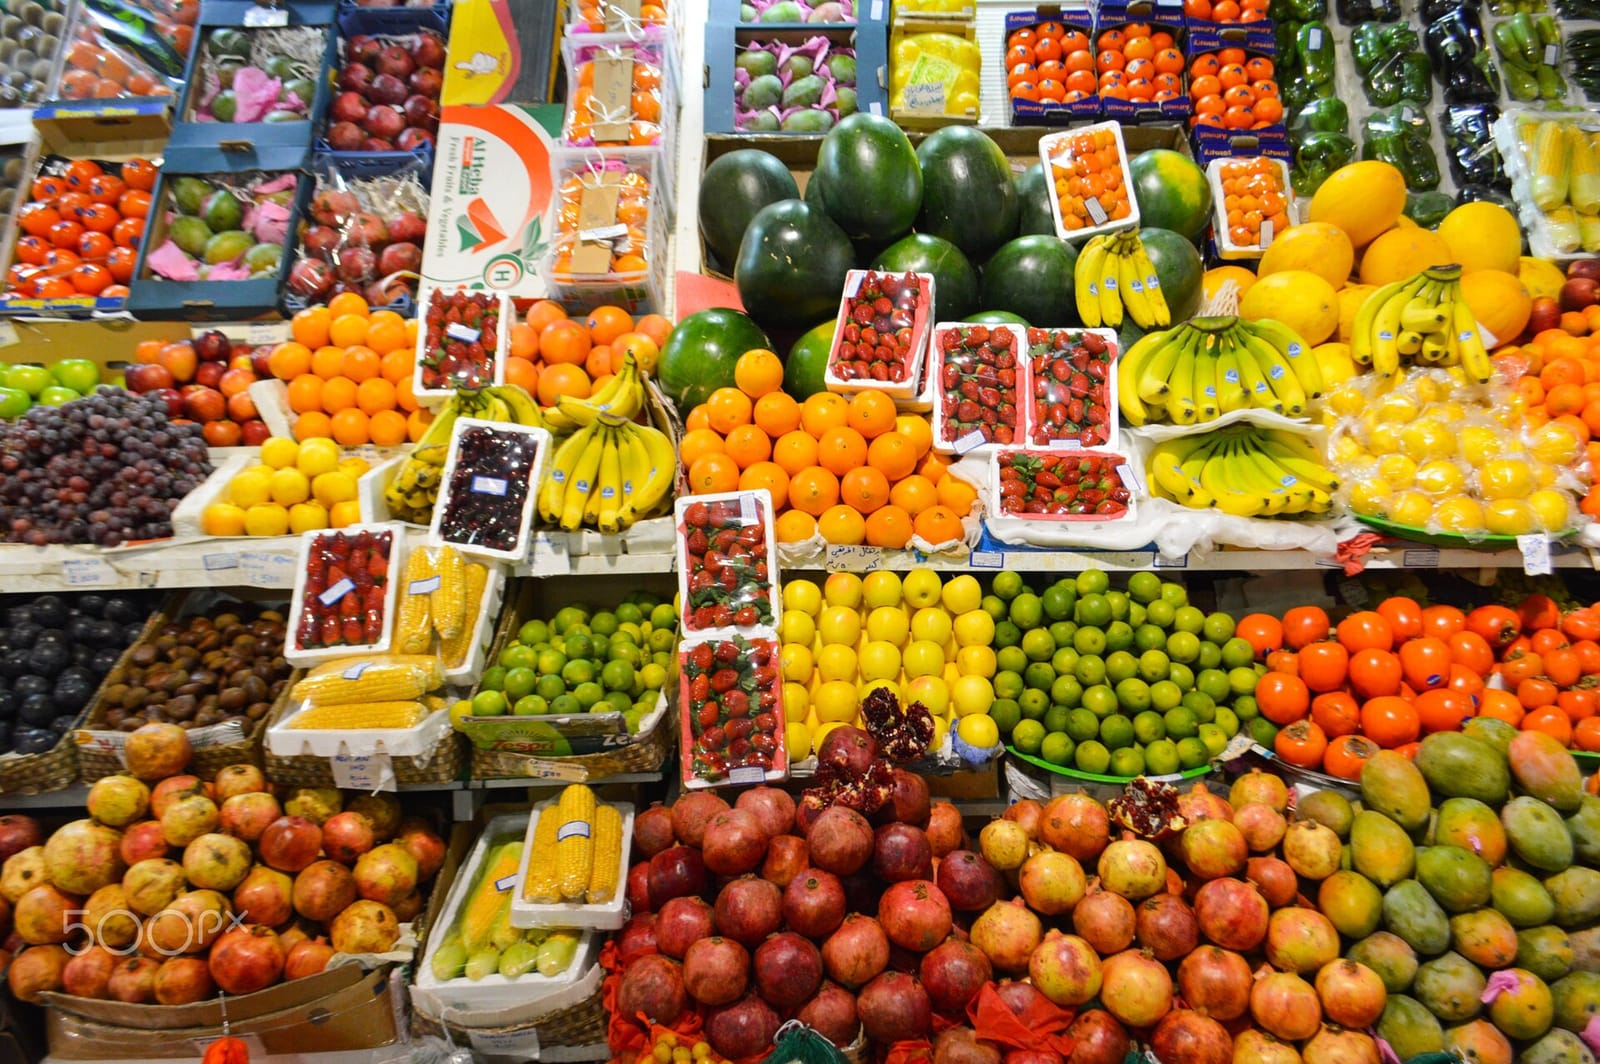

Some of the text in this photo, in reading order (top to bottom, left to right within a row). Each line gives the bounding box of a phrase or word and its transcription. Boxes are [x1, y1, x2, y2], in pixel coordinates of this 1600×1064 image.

[469, 137, 486, 195] Al Heba
[436, 136, 459, 258] Fresh Fruits & Vegetables
[494, 270, 510, 282] H
